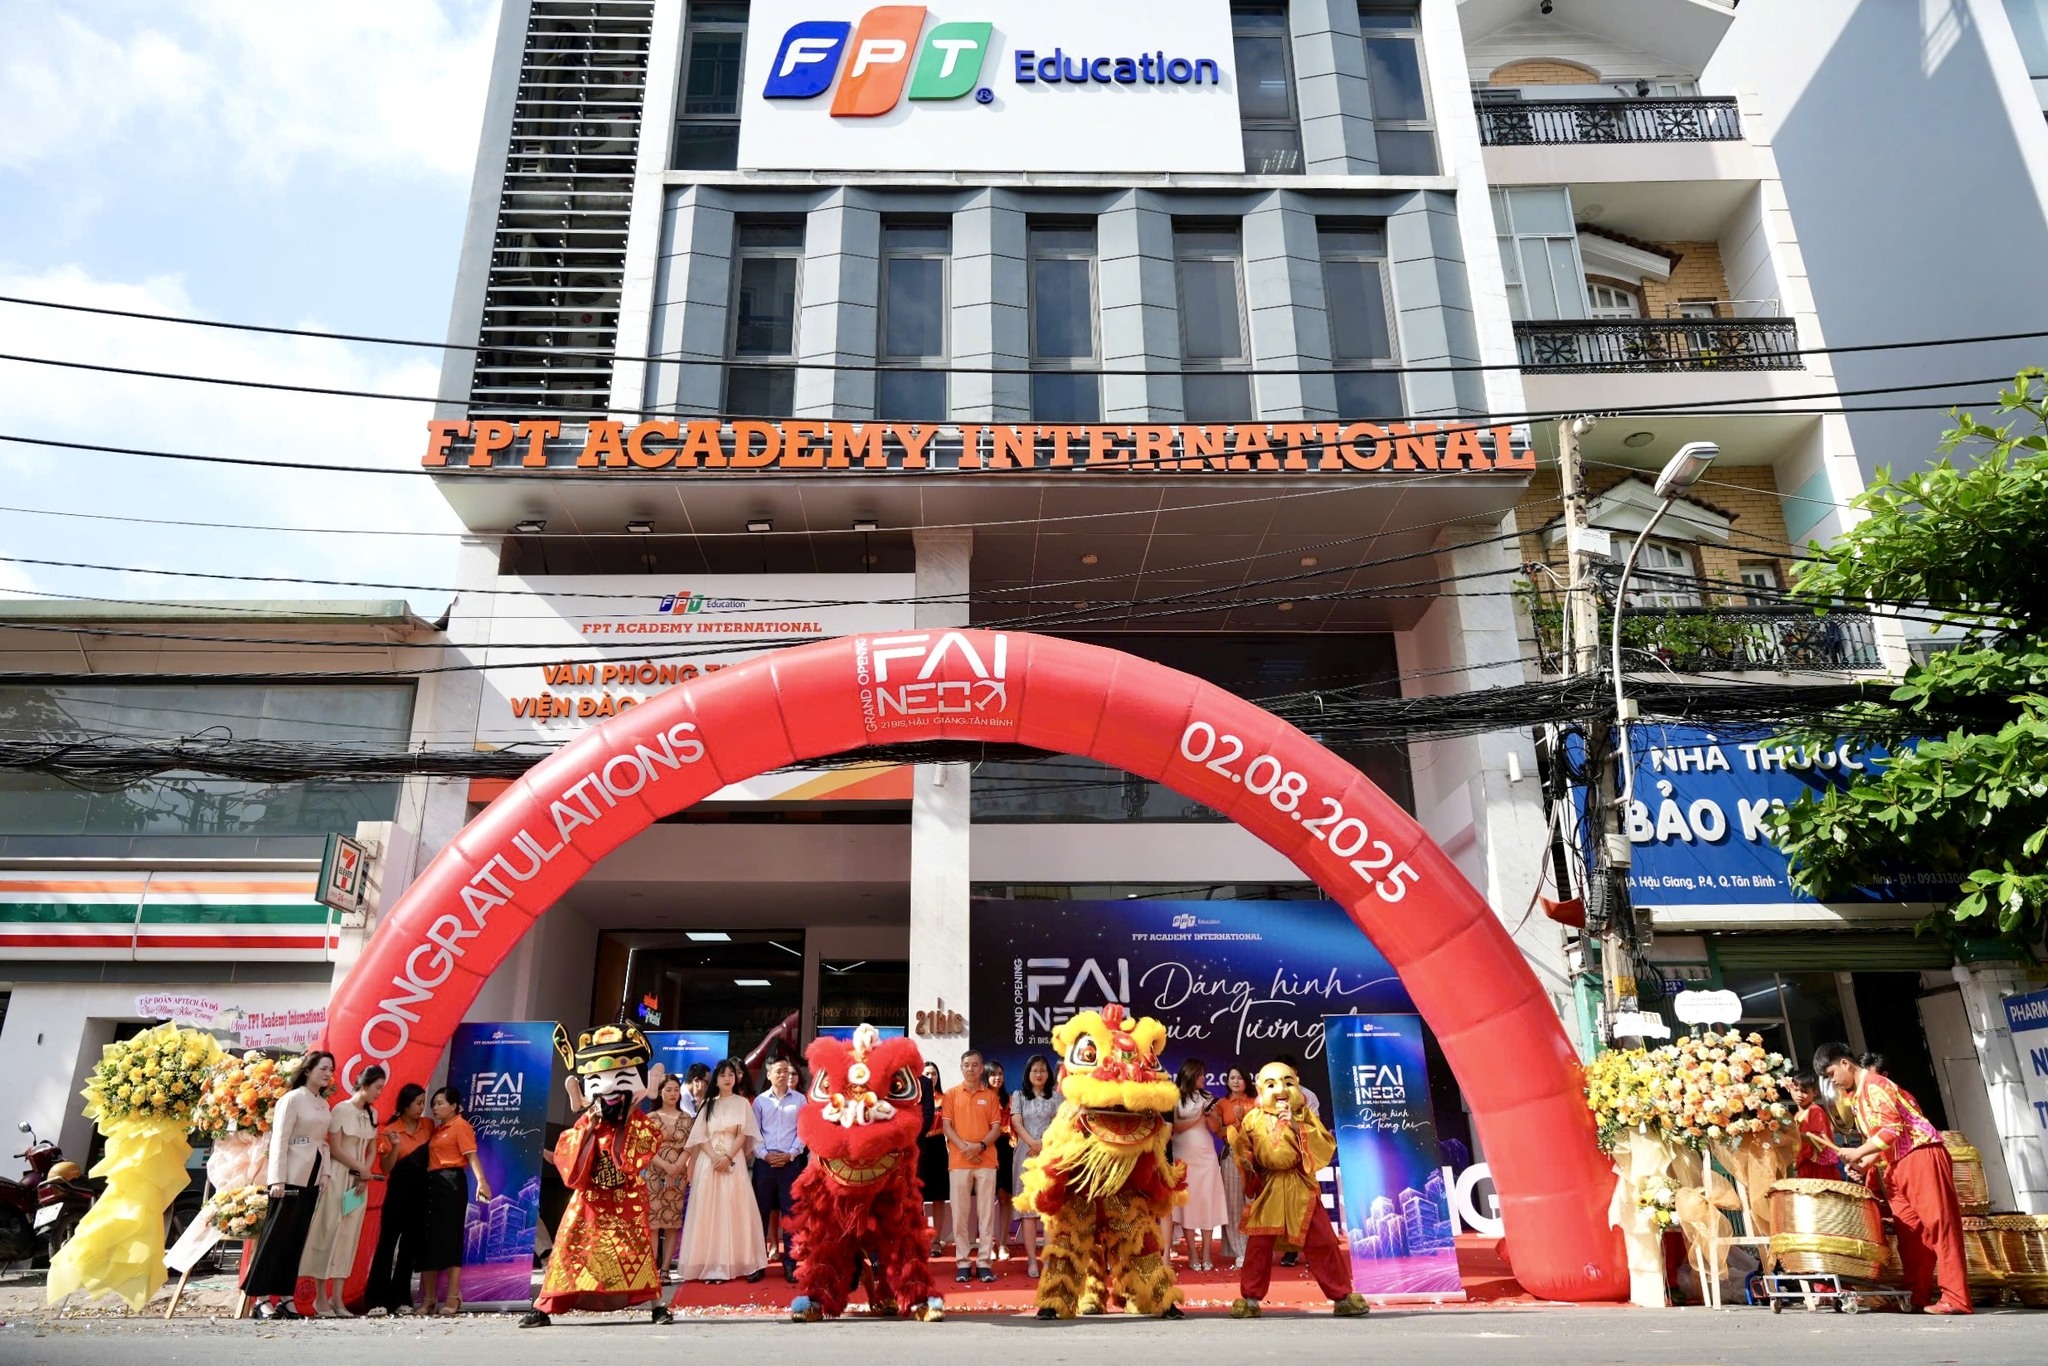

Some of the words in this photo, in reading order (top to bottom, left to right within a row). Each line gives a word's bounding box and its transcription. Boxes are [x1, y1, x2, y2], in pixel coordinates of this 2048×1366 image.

[1014, 48, 1219, 85] Education
[421, 420, 562, 467] FPT
[576, 420, 938, 470] ACADEMY
[958, 422, 1535, 471] INTERNATIONAL
[707, 600, 746, 610] Education
[582, 623, 612, 634] FPT
[615, 623, 693, 634] ACADEMY
[697, 622, 823, 634] INTERNATIONAL
[542, 660, 595, 685] VĂN
[601, 660, 698, 685] PHÒNG
[856, 638, 870, 685] OPENING
[872, 632, 1008, 683] FAI
[510, 692, 572, 724] VIỆN
[860, 689, 878, 733] GRAND
[1650, 734, 1730, 771] NHÀ
[1181, 721, 1420, 903] 02.08.2025
[1629, 779, 1726, 842] BẢO
[339, 866, 353, 880] ELEVEN
[341, 848, 357, 890] 7
[1639, 875, 1660, 890] Hậu
[1663, 875, 1696, 890] Giang,
[1752, 874, 1775, 887] Bình
[342, 722, 705, 1093] CONGRATULATIONS
[1014, 958, 1023, 1005] OPENING
[1027, 958, 1130, 1004] FAI
[1139, 962, 1256, 1013] Dáng
[1270, 967, 1400, 999] hình
[260, 1011, 288, 1032] Academy
[288, 1007, 326, 1027] International
[915, 1009, 963, 1035] 21bis
[1015, 1007, 1024, 1045] GRAND
[1165, 1017, 1212, 1040] ủa
[1028, 1036, 1036, 1045] 21
[476, 1072, 523, 1093] FAI
[1358, 1064, 1403, 1086] FAI
